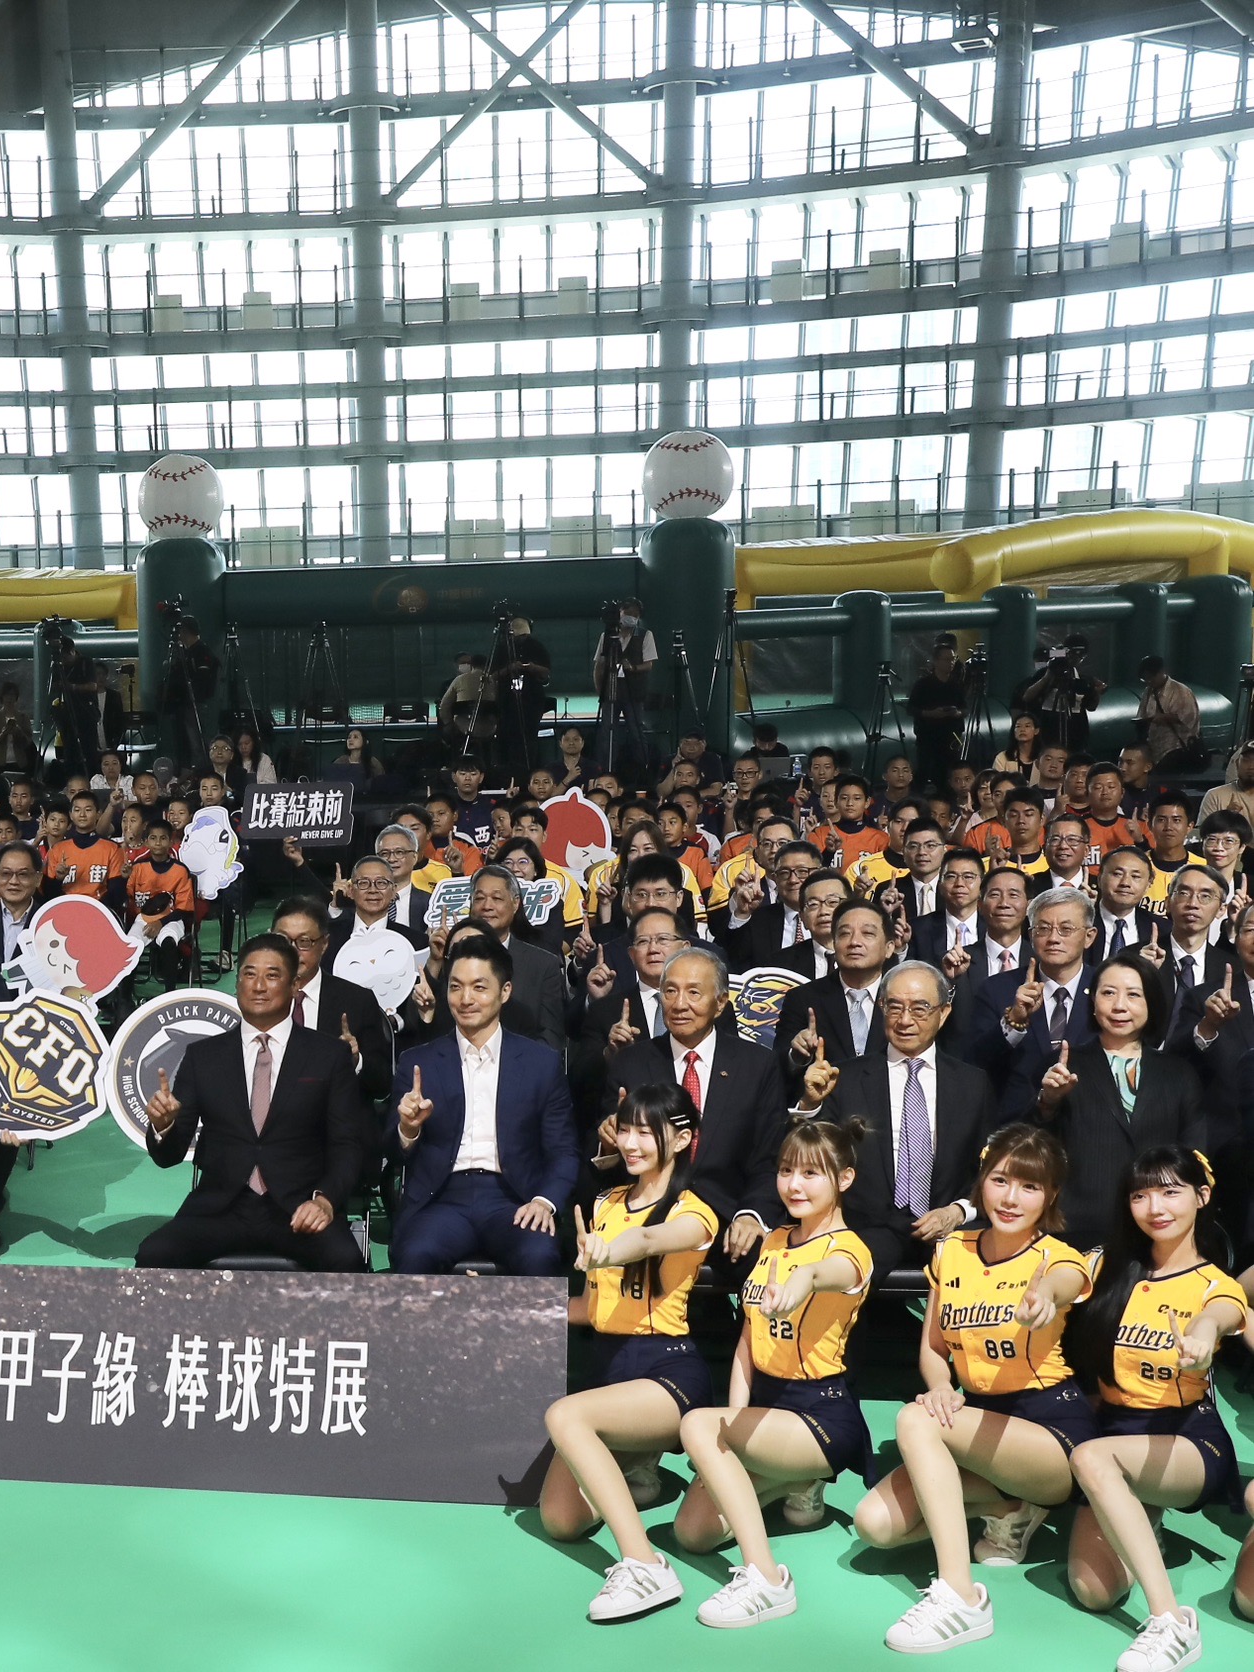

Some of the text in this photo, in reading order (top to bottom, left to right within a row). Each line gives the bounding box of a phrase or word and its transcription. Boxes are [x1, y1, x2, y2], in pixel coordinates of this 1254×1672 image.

[248, 789, 345, 830] 比賽結束前
[301, 829, 344, 840] NEVER GIVE UP
[59, 1019, 76, 1036] CTBC
[157, 1005, 238, 1029] BLACK PANT
[736, 1021, 762, 1040] TBC
[2, 1007, 95, 1098] CFO
[122, 1075, 151, 1128] HIGH SCHOOL
[11, 1107, 56, 1127] OYSTER
[939, 1300, 1016, 1331] Brothers
[768, 1318, 794, 1341] 22
[1115, 1322, 1176, 1352] others
[984, 1338, 1017, 1360] 88
[1140, 1361, 1174, 1381] 29
[162, 1334, 369, 1437] 棒球特展
